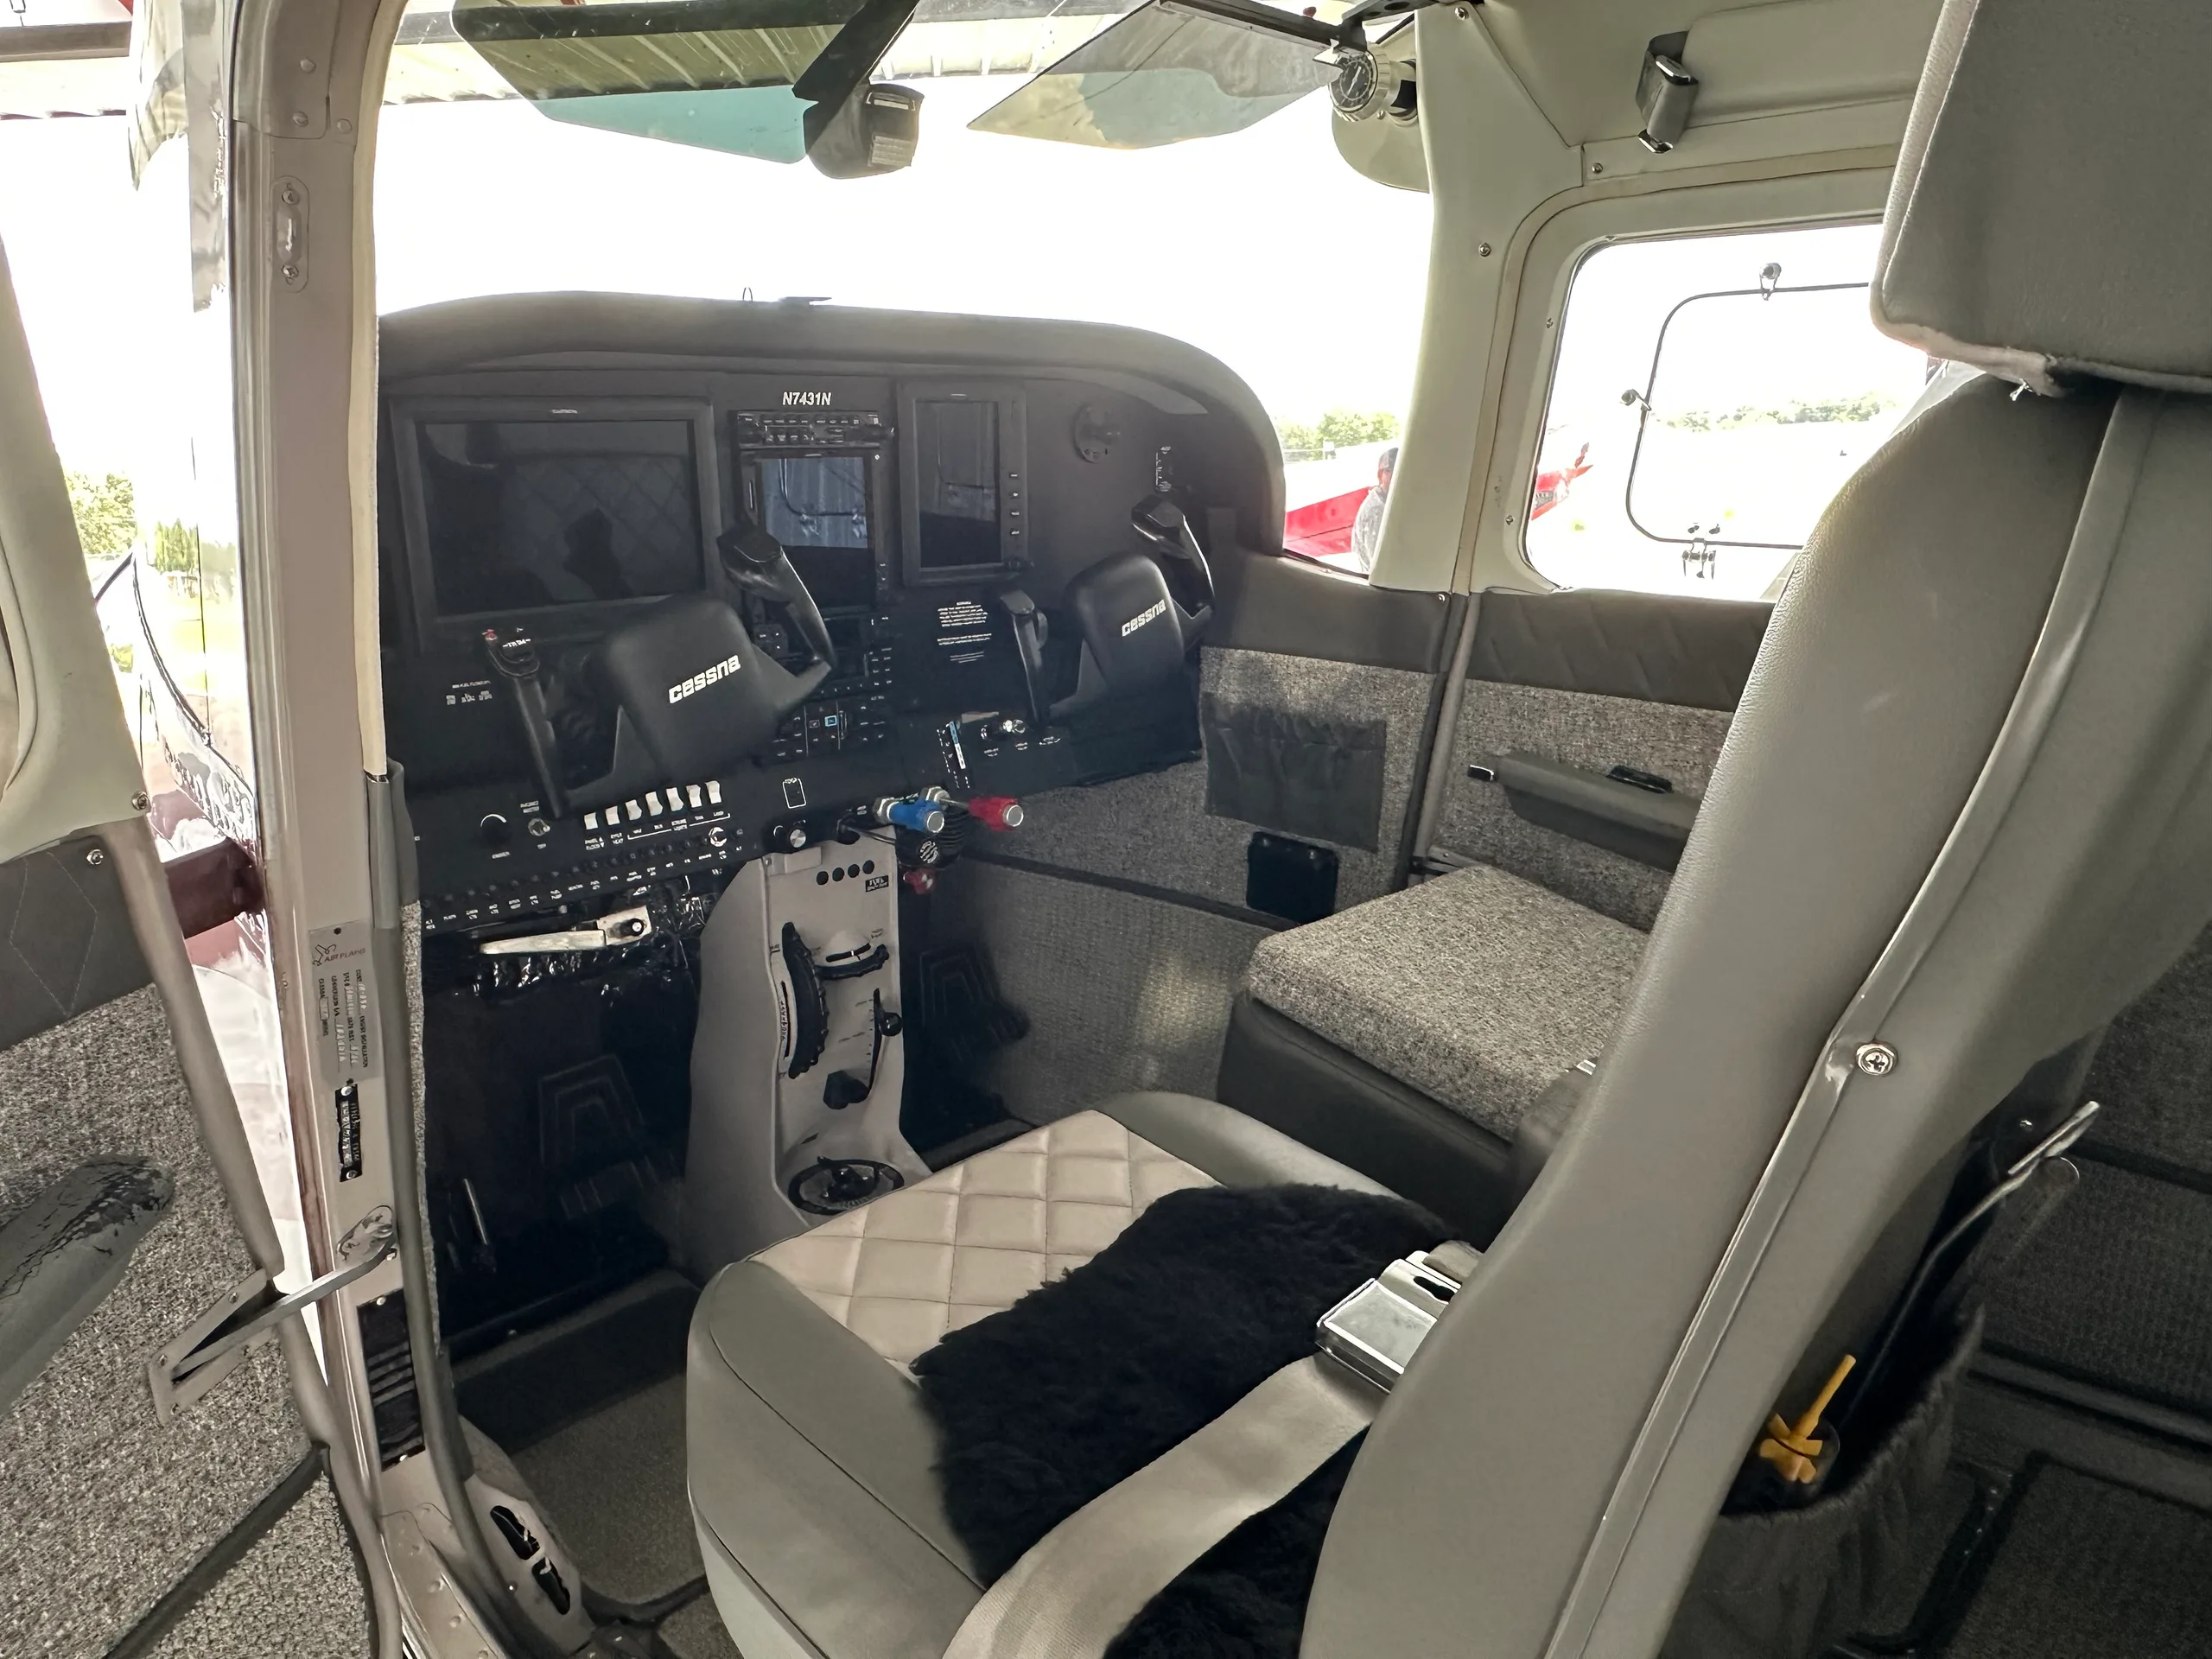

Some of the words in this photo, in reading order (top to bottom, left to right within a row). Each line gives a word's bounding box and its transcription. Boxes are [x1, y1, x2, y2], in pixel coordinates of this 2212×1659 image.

[782, 391, 831, 406] N7431N
[1122, 599, 1166, 637] cessna
[668, 654, 741, 703] cessna
